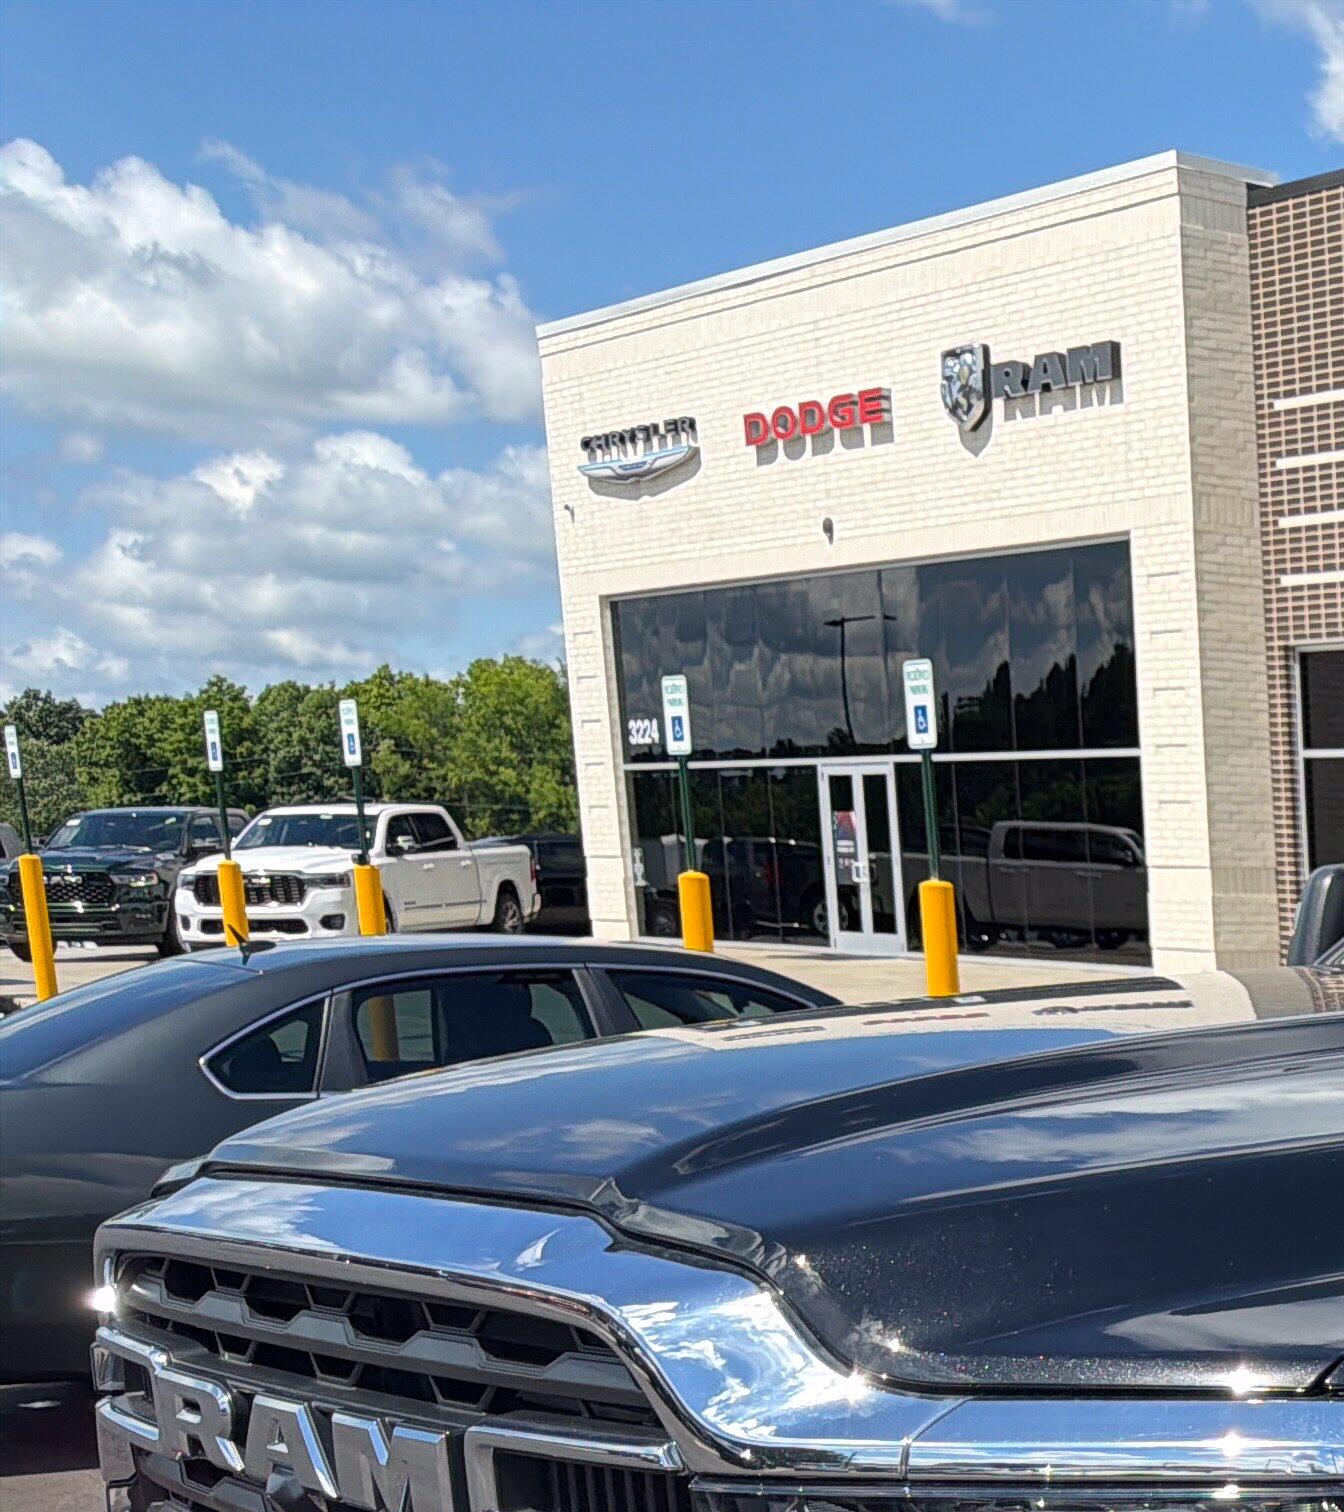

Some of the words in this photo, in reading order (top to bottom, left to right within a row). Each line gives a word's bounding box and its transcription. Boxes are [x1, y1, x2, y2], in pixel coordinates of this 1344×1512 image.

[991, 340, 1119, 399] RAM
[580, 416, 697, 453] CHRYSLER
[743, 387, 889, 447] DODGE
[628, 717, 660, 745] 3224
